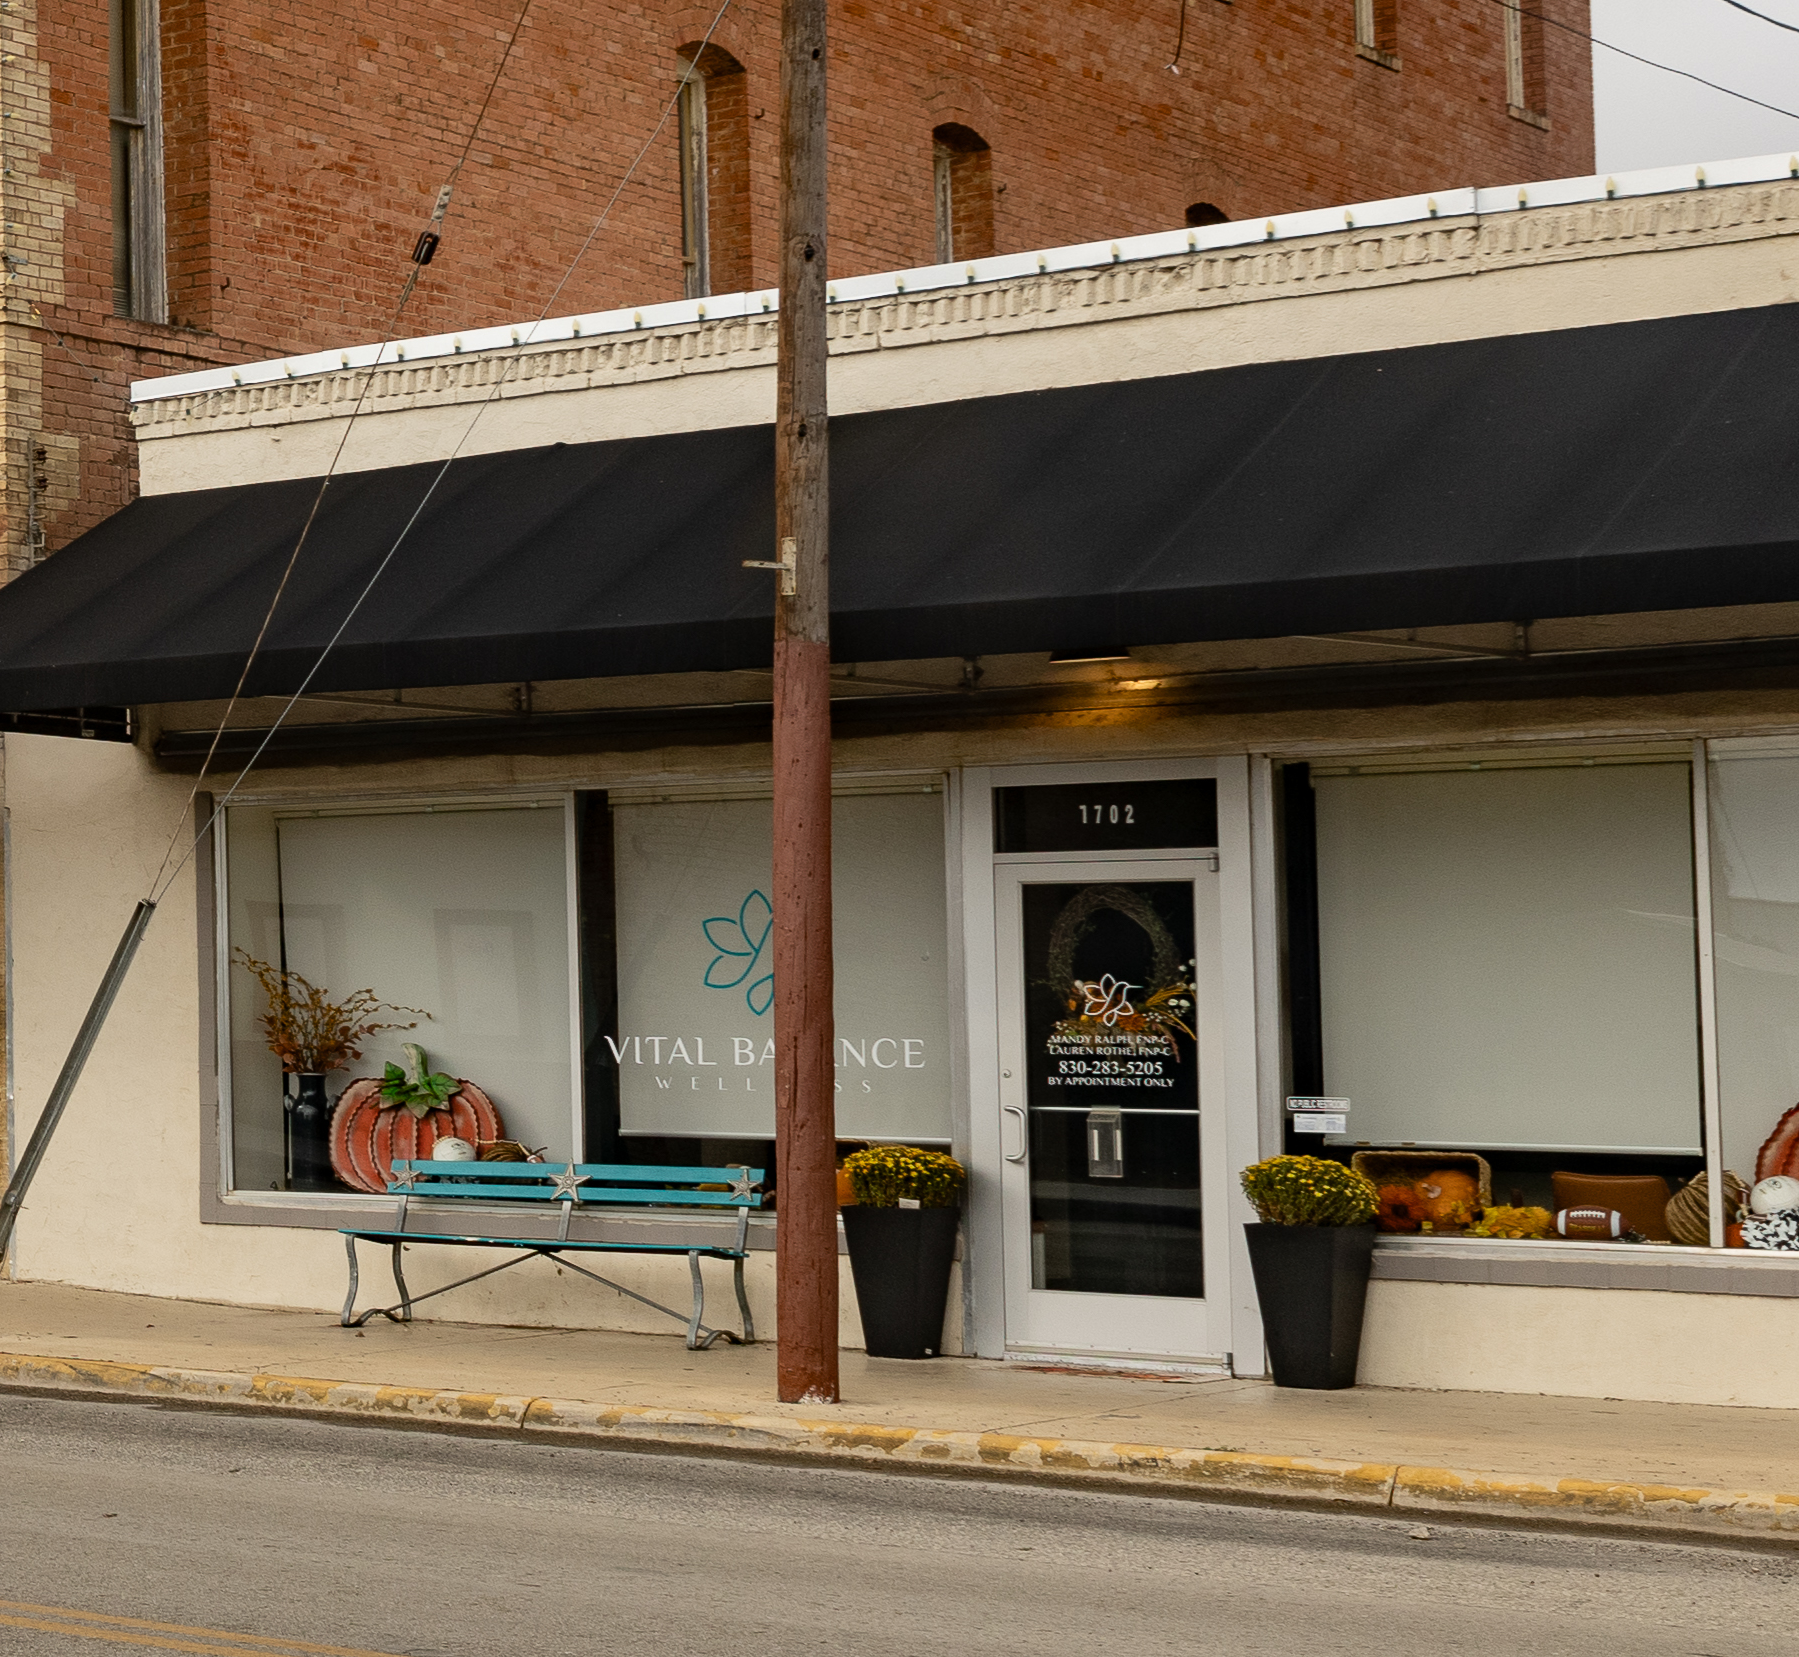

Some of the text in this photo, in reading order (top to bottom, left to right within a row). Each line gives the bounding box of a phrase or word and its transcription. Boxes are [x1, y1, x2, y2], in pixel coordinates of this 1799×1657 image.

[1079, 805, 1135, 824] 1702
[1050, 1035, 1092, 1044] MANDY
[604, 1035, 926, 1068] VITAL BANCE
[1049, 1046, 1094, 1055] LAUREN
[1059, 1060, 1164, 1075] 830-283-5205
[655, 1076, 872, 1094] WELLSS
[1048, 1076, 1175, 1087] BY APPOINTMENT ONLY
